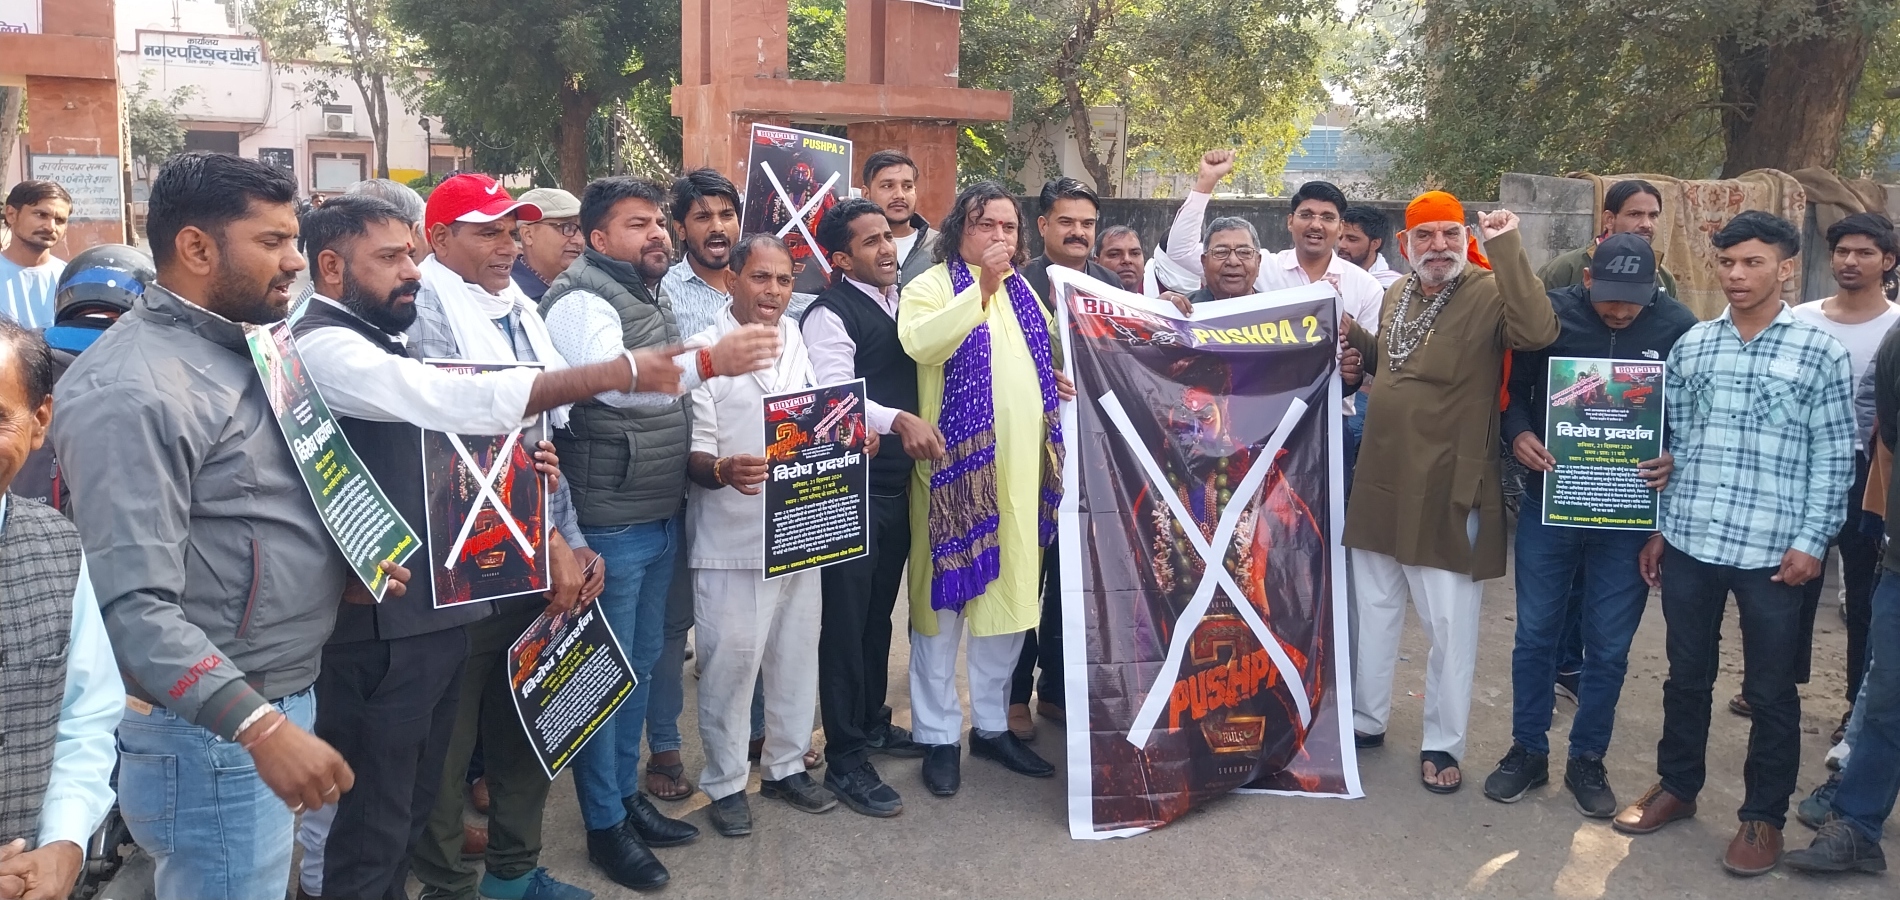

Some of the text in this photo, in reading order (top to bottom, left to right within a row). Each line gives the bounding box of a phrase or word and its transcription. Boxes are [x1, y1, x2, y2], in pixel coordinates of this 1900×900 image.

[187, 36, 219, 46] कार्यालय
[803, 138, 838, 154] PUSHPA
[839, 146, 844, 155] 2
[1606, 256, 1640, 274] 46
[1192, 320, 1300, 345] PUSHPA
[1302, 316, 1322, 342] 2
[773, 396, 815, 410] BOYCOTT
[294, 431, 318, 465] विरोध
[315, 416, 337, 453] प्रदर्शन
[1556, 422, 1654, 440] विरोध प्रदर्शन
[773, 462, 813, 482] विरोध
[816, 451, 860, 475] प्रदर्शन
[522, 654, 555, 699] विरोध
[555, 608, 594, 660] प्रदर्शन
[168, 655, 223, 700] NAUTICA
